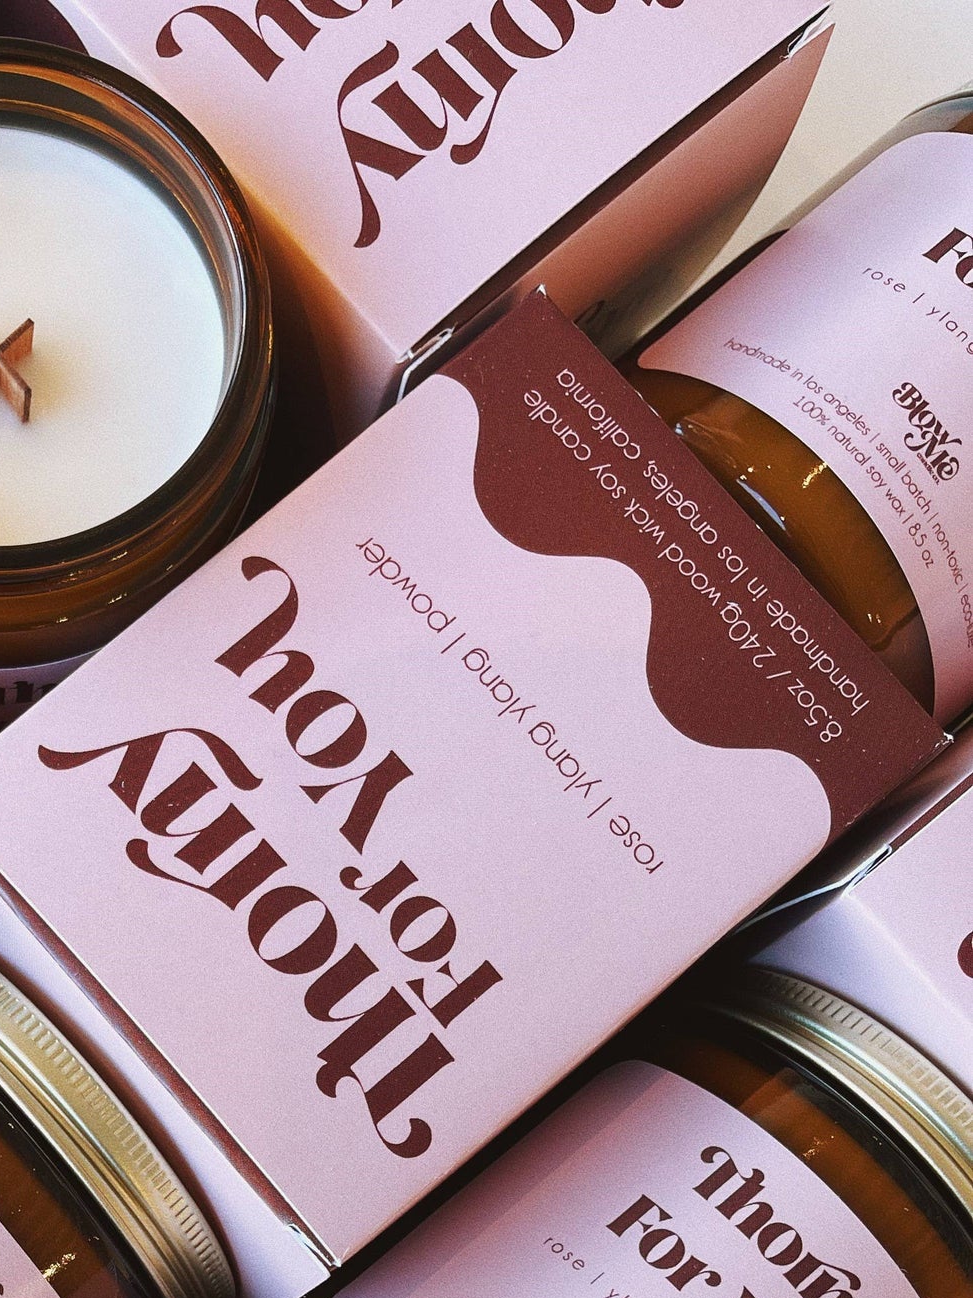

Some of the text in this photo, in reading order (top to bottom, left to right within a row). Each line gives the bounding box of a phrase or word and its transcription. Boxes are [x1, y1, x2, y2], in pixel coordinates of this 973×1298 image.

[523, 389, 842, 743] 8.5oz 240g wood wick soy candle
[556, 368, 870, 716] handmade in los angeles, california
[892, 382, 962, 445] Blow
[214, 556, 503, 1029] For You
[355, 537, 664, 874] rose ylang ylang powder
[38, 728, 455, 1159] Thorny
[543, 1237, 585, 1271] rose
[606, 1194, 722, 1292] For
